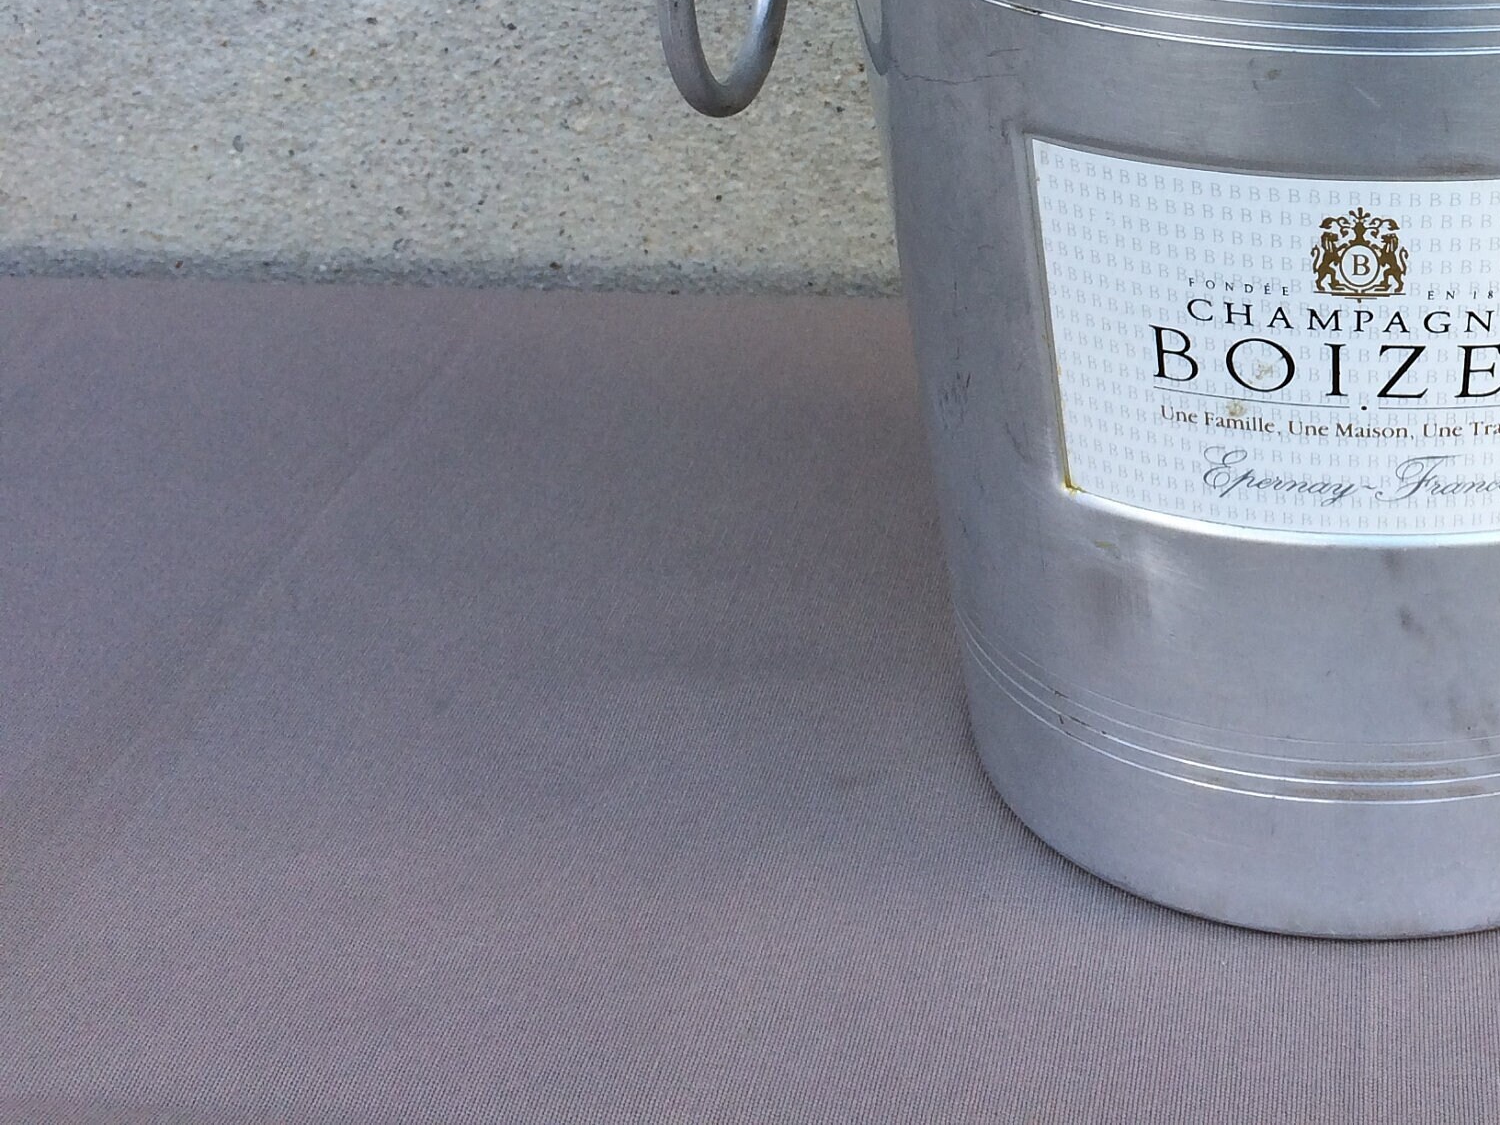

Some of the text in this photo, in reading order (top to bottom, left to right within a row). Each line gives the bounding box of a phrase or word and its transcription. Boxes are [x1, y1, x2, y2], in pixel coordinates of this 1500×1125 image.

[1188, 277, 1290, 297] FONDÉE
[1427, 289, 1456, 301] EN
[1160, 404, 1198, 425] Une
[1204, 411, 1281, 436] Famille,
[1288, 420, 1329, 437] Une
[1335, 423, 1415, 440] Maison,
[1422, 423, 1463, 438] Une
